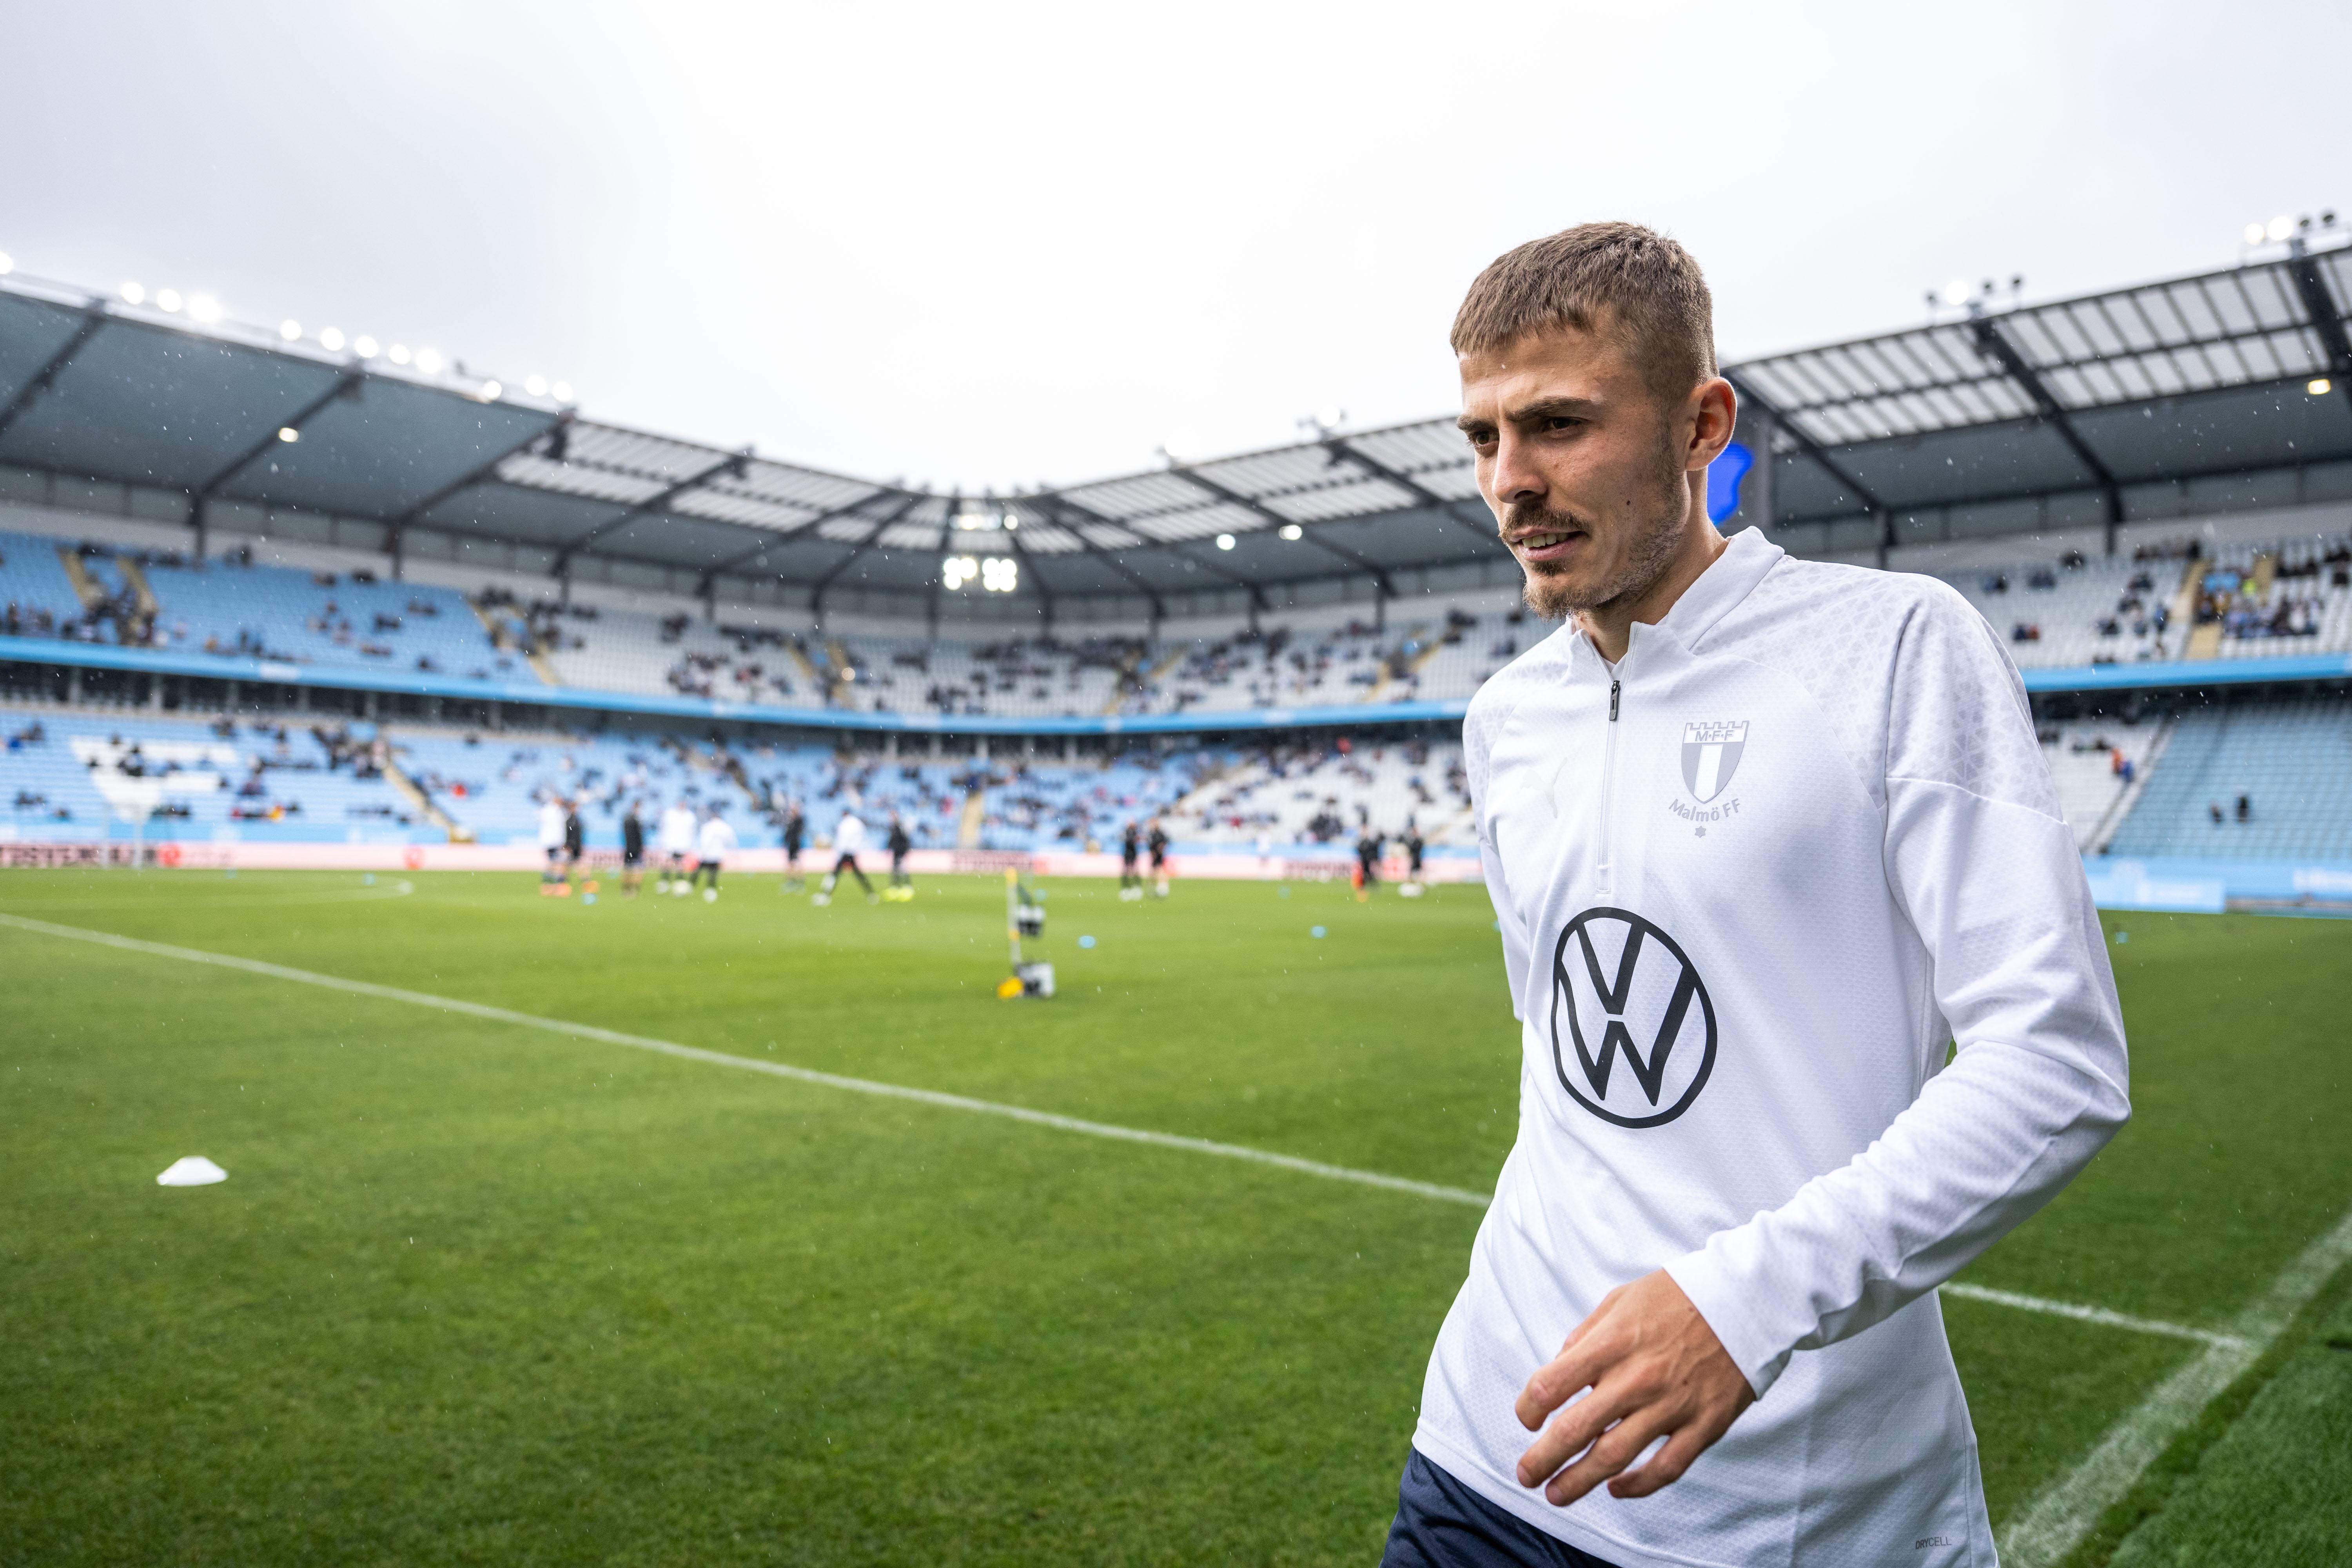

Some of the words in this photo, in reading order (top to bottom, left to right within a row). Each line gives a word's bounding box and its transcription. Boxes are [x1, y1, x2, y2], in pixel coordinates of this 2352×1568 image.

[1669, 799, 1719, 822] Malmö
[1722, 798, 1740, 817] FF
[1555, 915, 1699, 1107] VW
[1916, 1536, 1952, 1549] DRYCELL
